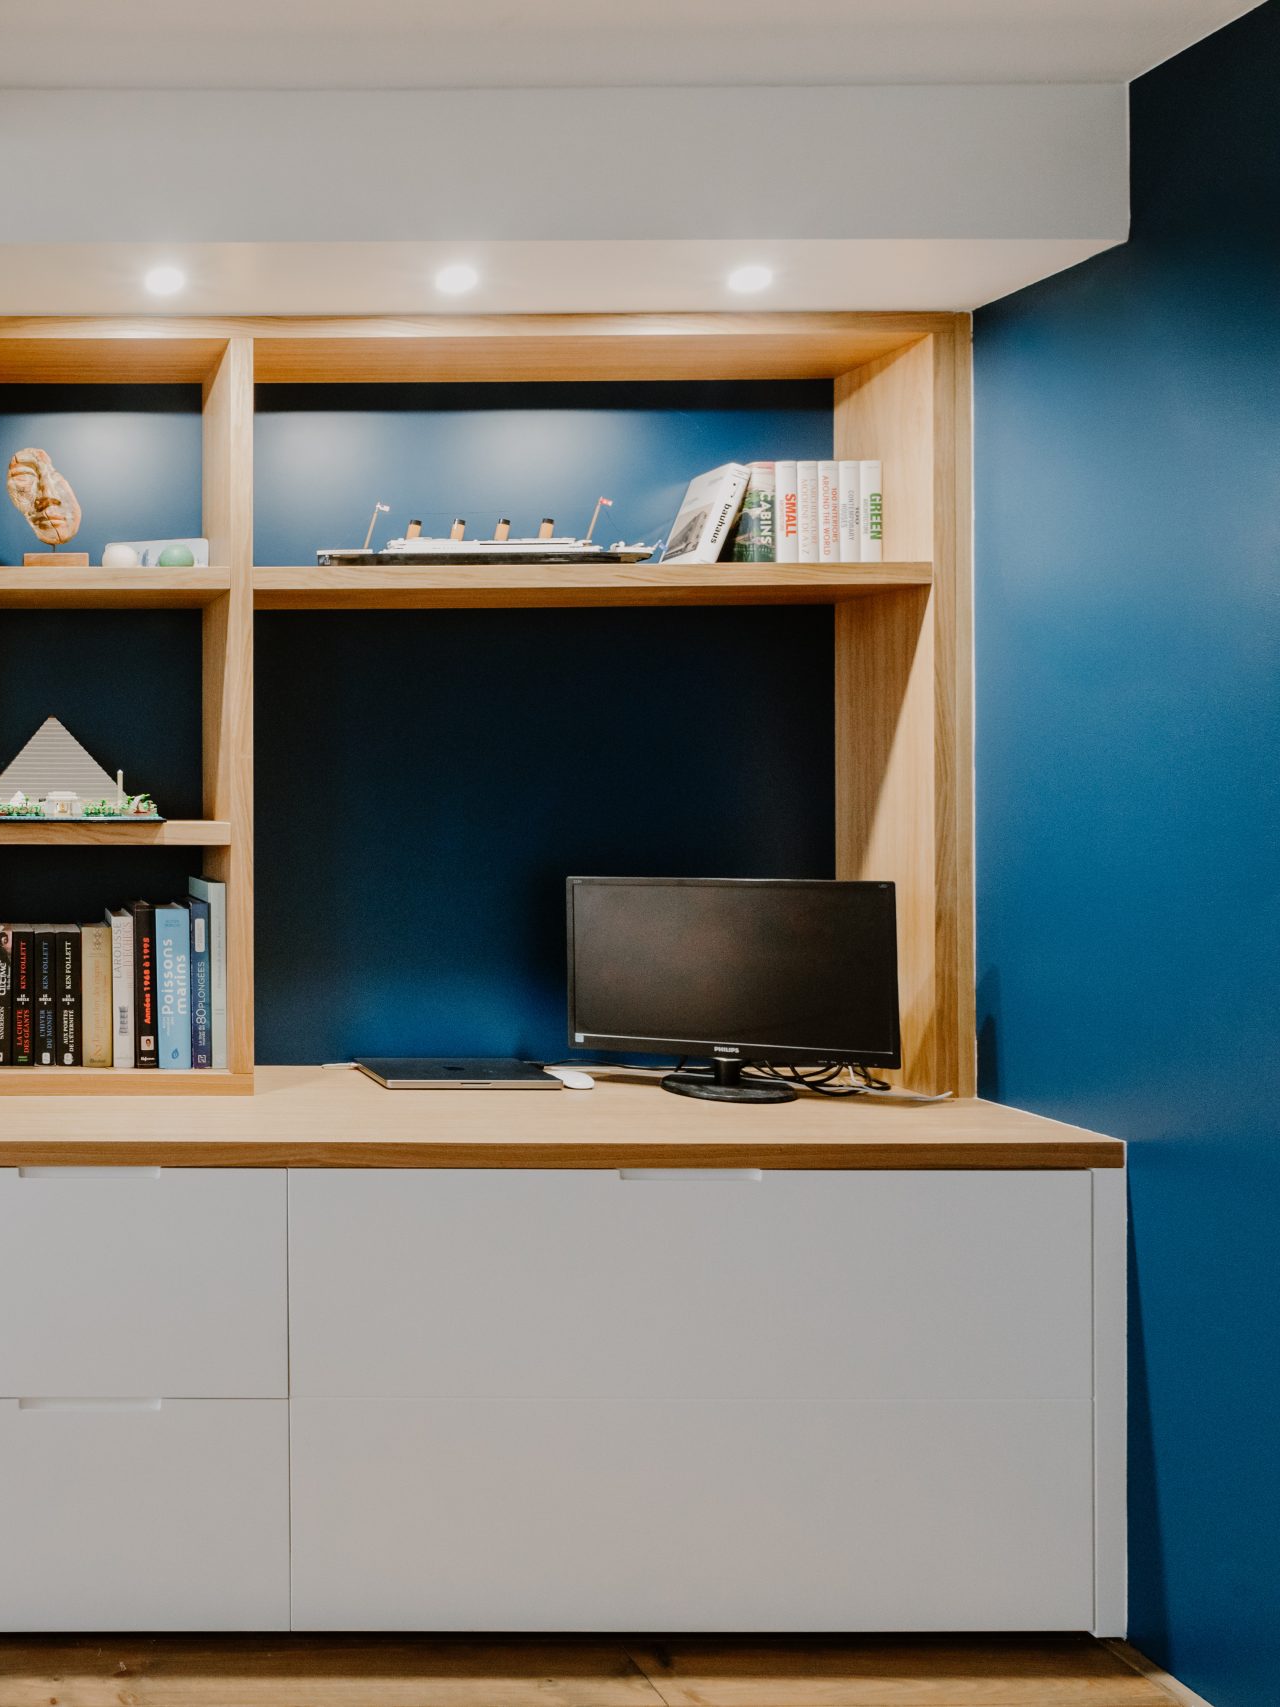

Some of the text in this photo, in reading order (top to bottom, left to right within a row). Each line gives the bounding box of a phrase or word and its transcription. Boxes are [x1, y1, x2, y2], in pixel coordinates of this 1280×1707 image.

[822, 476, 830, 509] AROUND
[711, 504, 732, 544] bauhaus
[760, 492, 772, 545] CABINS
[785, 494, 796, 537] SMALL
[870, 493, 882, 540] GREEN
[162, 939, 174, 1014] Poissons
[175, 954, 187, 1014] marins
[198, 961, 206, 1008] PLONGÉES
[143, 993, 151, 1024] Années
[196, 1008, 206, 1024] 80
[17, 1035, 22, 1045] LA
[47, 1039, 52, 1049] DU
[69, 1043, 74, 1052] DE
